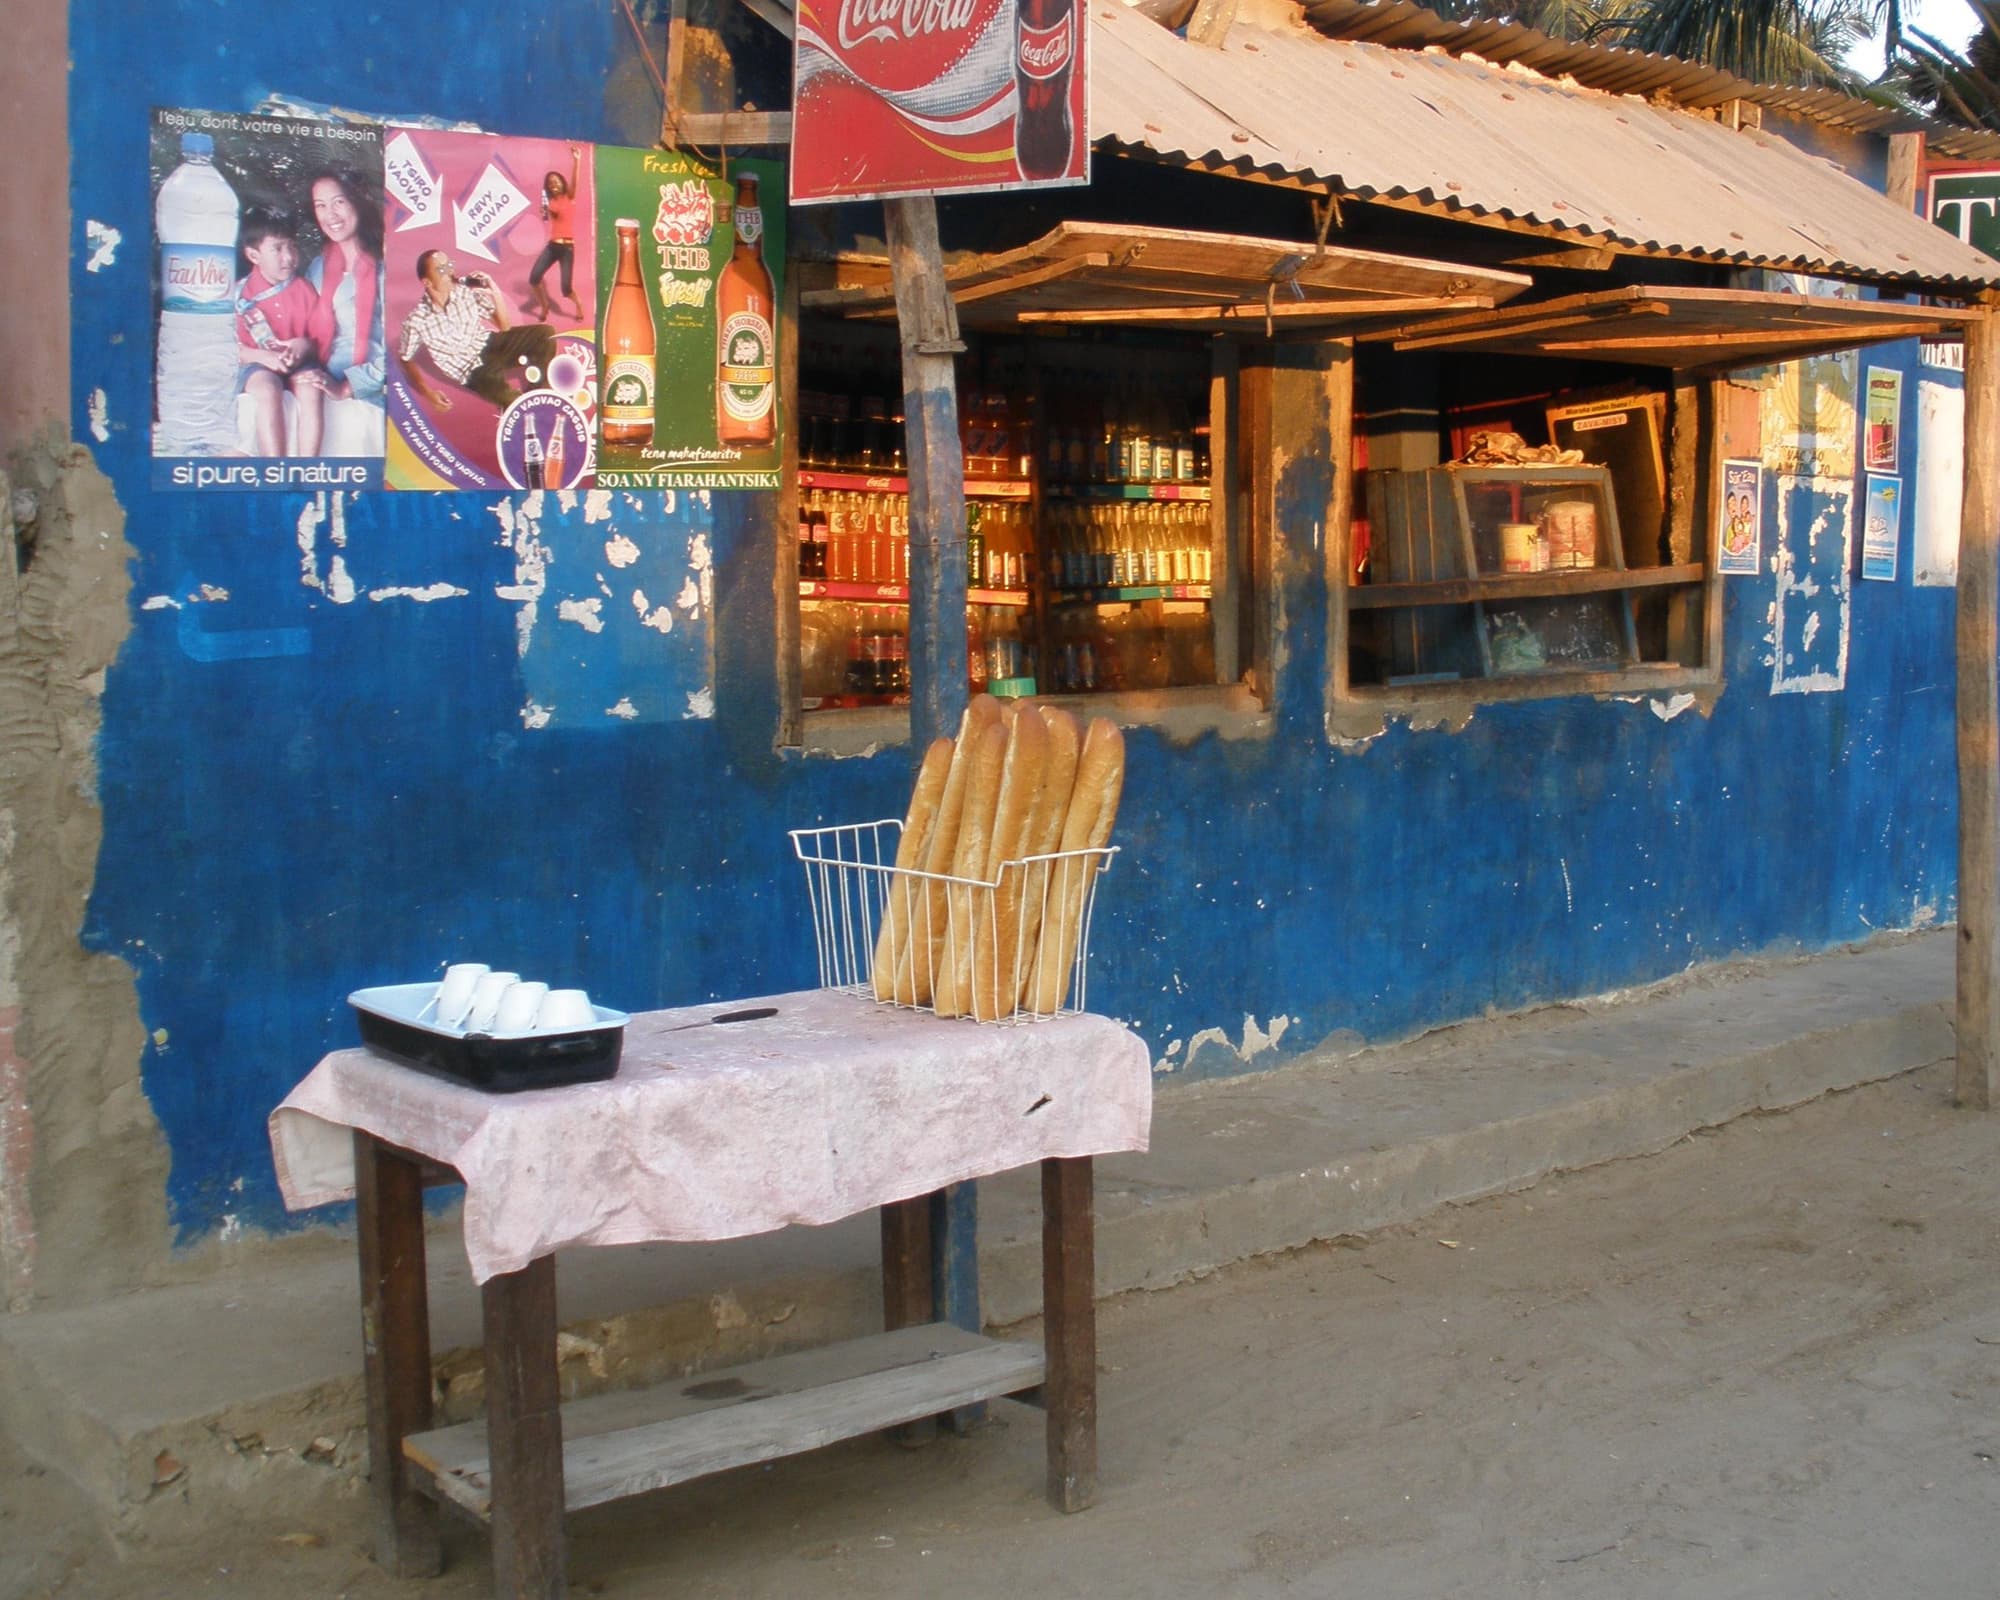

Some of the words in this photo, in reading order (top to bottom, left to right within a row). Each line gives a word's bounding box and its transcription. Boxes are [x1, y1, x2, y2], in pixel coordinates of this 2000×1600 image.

[159, 110, 195, 128] l'eau
[201, 115, 238, 131] dont
[243, 118, 282, 135] votre
[287, 123, 310, 137] vie
[313, 128, 324, 138] a
[326, 124, 377, 142] besoin
[643, 155, 688, 174] Fresh
[387, 160, 427, 212] VAOVAO
[467, 189, 494, 220] REVY
[468, 193, 511, 238] VAOVAO
[736, 212, 761, 225] THB
[657, 246, 710, 270] THB
[659, 271, 712, 307] Fresh
[1919, 343, 1947, 366] VITA
[520, 395, 562, 411] VAOVAO
[172, 461, 195, 484] si
[197, 465, 261, 488] pure,
[264, 461, 285, 484] si
[288, 461, 368, 484] nature
[597, 473, 631, 488] SOA
[632, 473, 655, 488] NY
[658, 473, 780, 488] FIARAHANTSIKA
